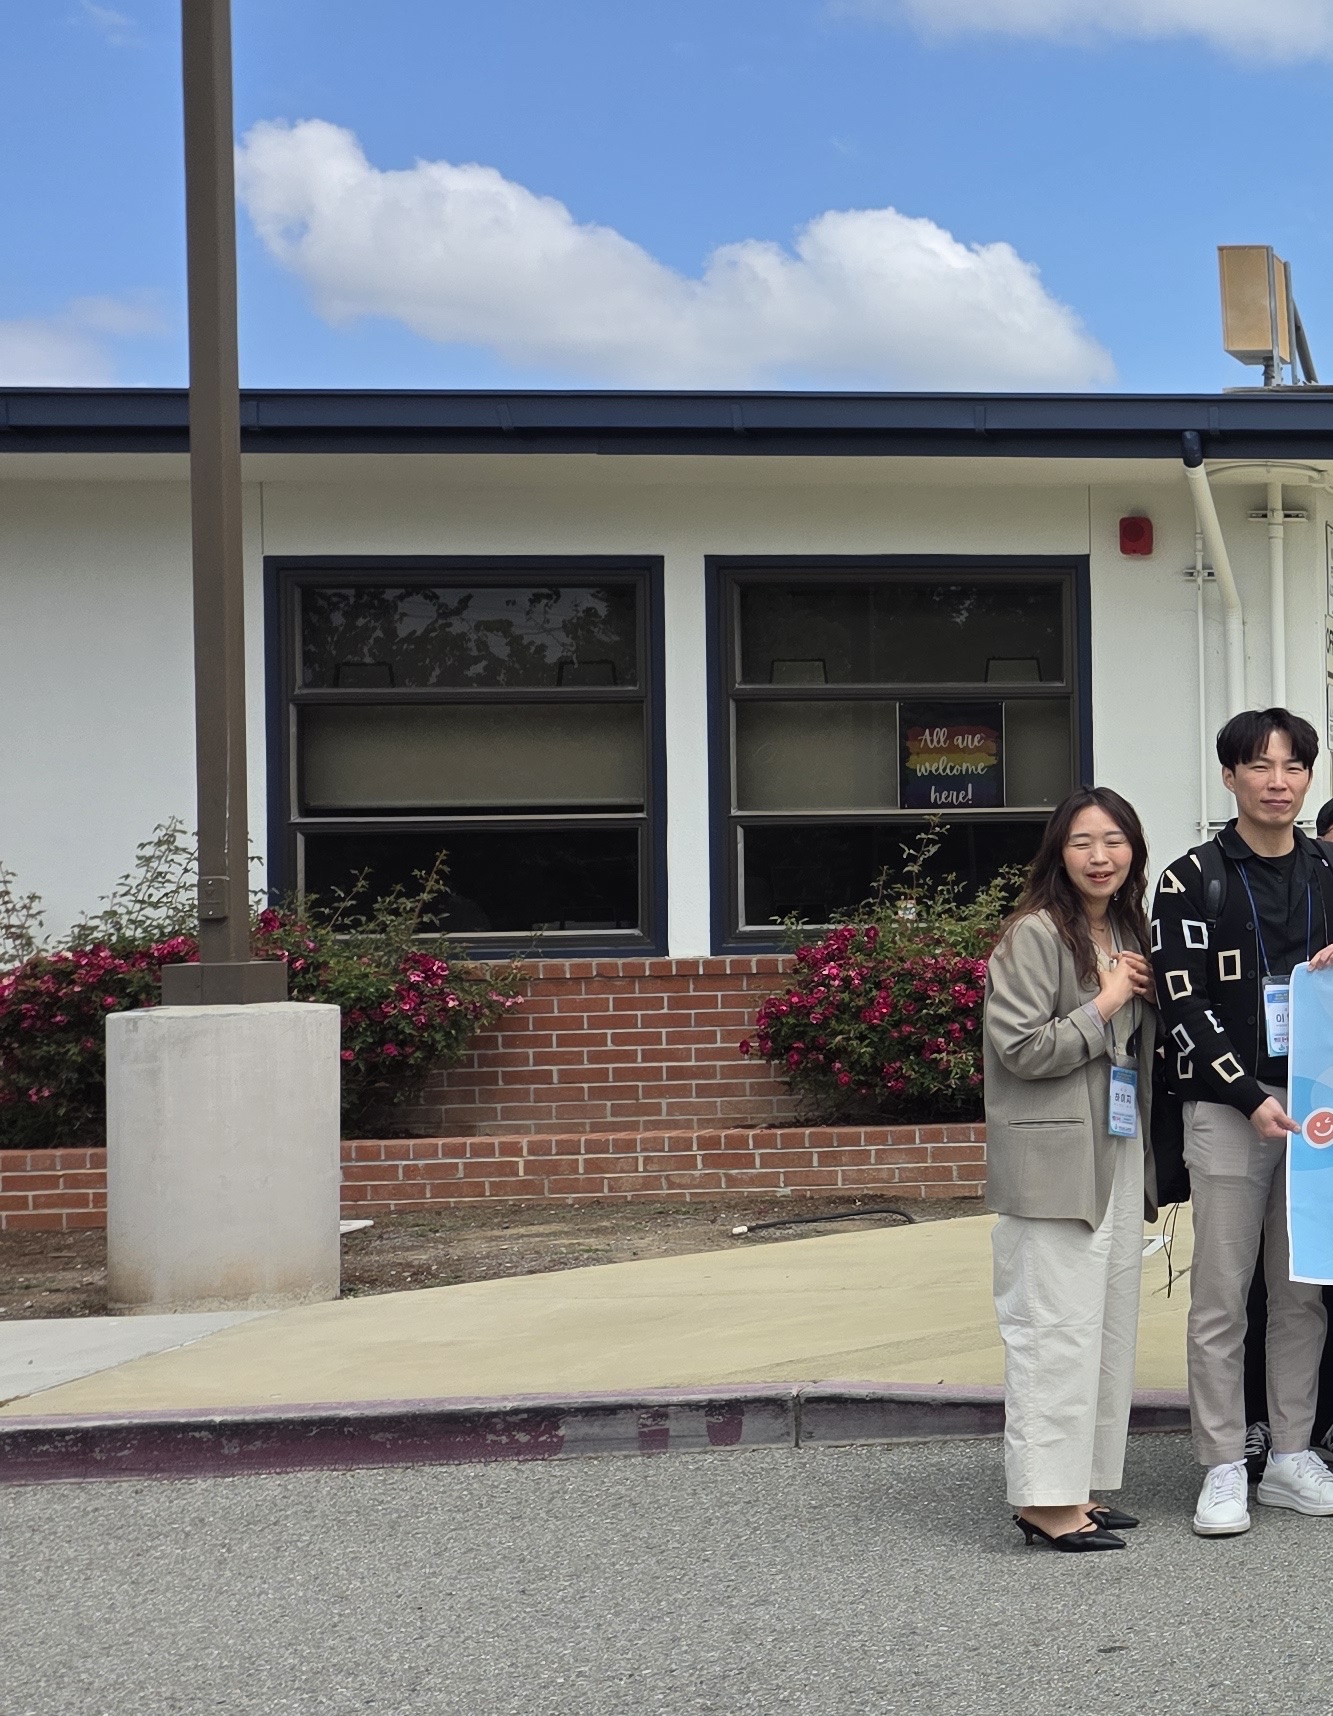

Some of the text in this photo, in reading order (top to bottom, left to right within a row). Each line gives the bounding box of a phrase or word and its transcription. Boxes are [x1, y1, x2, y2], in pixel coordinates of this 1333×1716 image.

[918, 728, 986, 749] All are
[916, 756, 988, 777] welcome
[930, 783, 973, 805] here!
